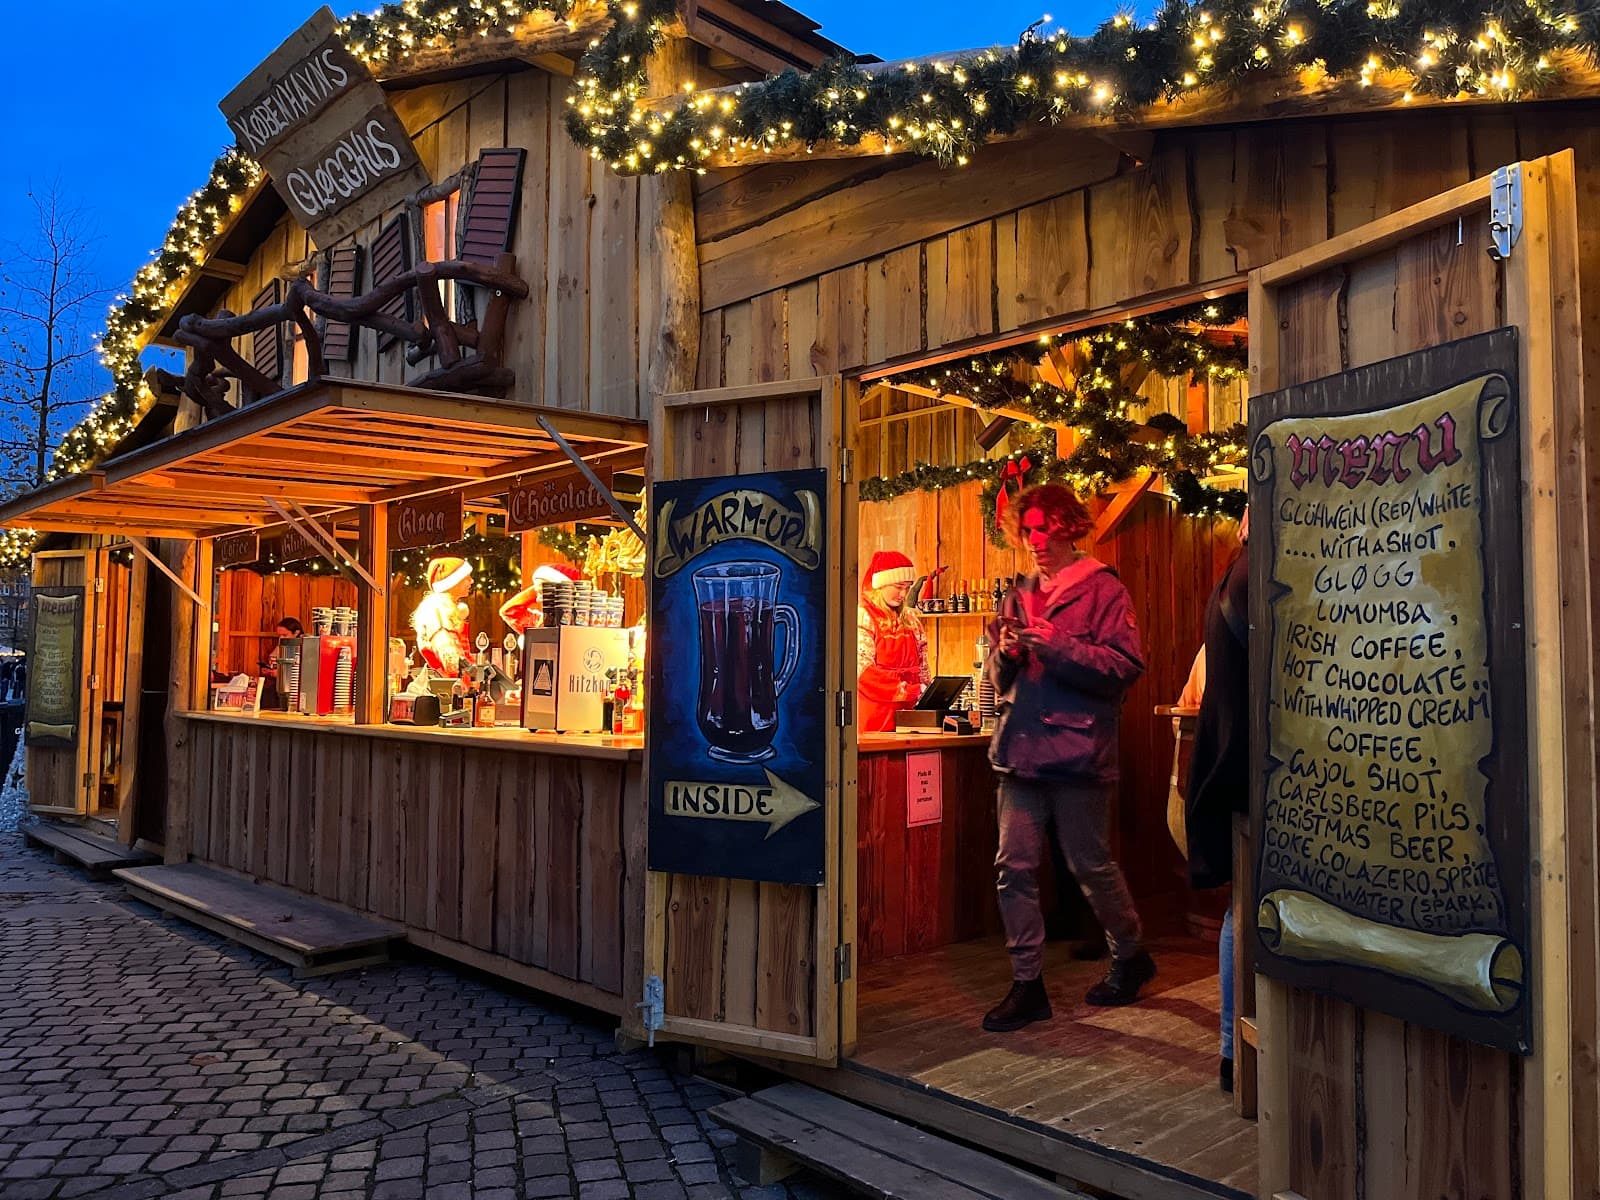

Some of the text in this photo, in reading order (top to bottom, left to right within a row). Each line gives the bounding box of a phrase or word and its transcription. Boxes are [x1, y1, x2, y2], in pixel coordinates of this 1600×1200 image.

[234, 49, 348, 152] KØBENHAVNS
[287, 120, 400, 215] GLØGGHUS
[668, 496, 805, 560] WARM-UP
[1315, 561, 1414, 594] GLØGG
[1287, 621, 1337, 656] IRISH
[1283, 651, 1323, 682] HOT
[1326, 694, 1401, 726] WHIPPED
[1407, 692, 1490, 729] CREAM
[672, 786, 774, 815] INSIDE
[1279, 775, 1402, 830] CARLSBERG
[1266, 799, 1371, 849] CHRISTMAS
